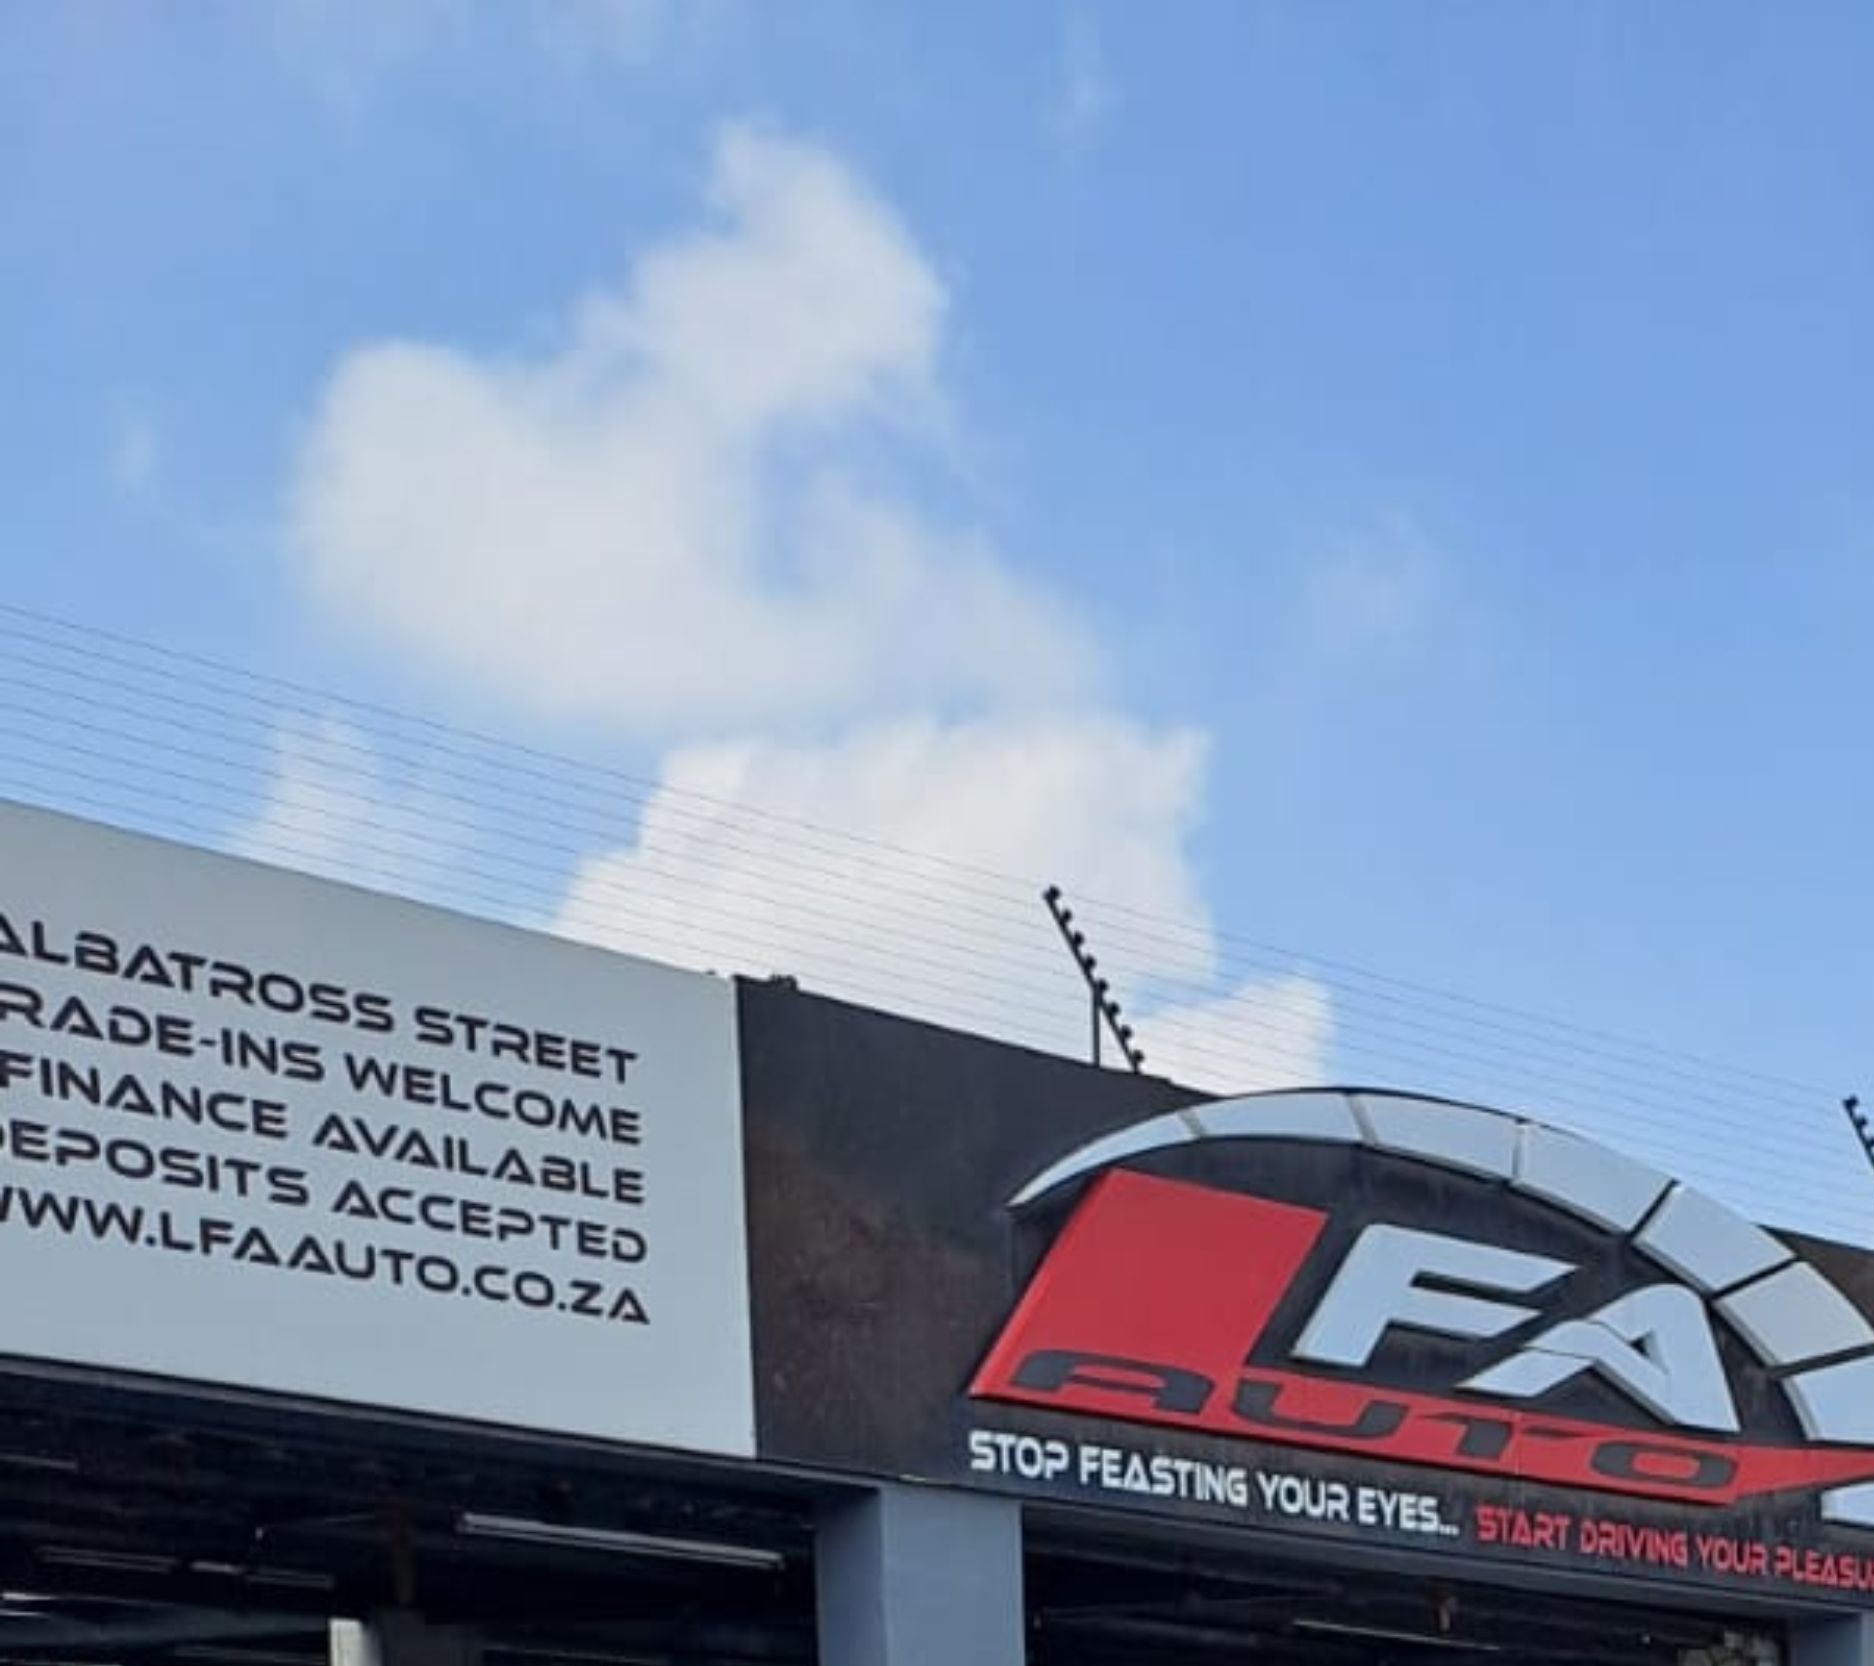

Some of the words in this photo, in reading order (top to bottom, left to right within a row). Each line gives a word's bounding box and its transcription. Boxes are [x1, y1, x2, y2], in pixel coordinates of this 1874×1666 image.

[345, 1053, 642, 1145] WELCOME
[415, 1007, 638, 1084] STREET
[0, 1052, 288, 1138] FINANCE
[312, 1114, 644, 1204] AVAILABLE
[0, 1119, 309, 1206] EPOSITS
[333, 1180, 647, 1263] ACCEPTED
[0, 1186, 650, 1325] WW.LFAAUTO.CO.ZA
[968, 1431, 1069, 1480] STOP
[1079, 1446, 1249, 1507] FEASTING
[1257, 1471, 1350, 1522] YOUR
[1010, 1349, 1738, 1490] AUTO
[1476, 1505, 1571, 1551] START
[1579, 1518, 1689, 1566] DRIVING
[1699, 1537, 1767, 1576] YOUR
